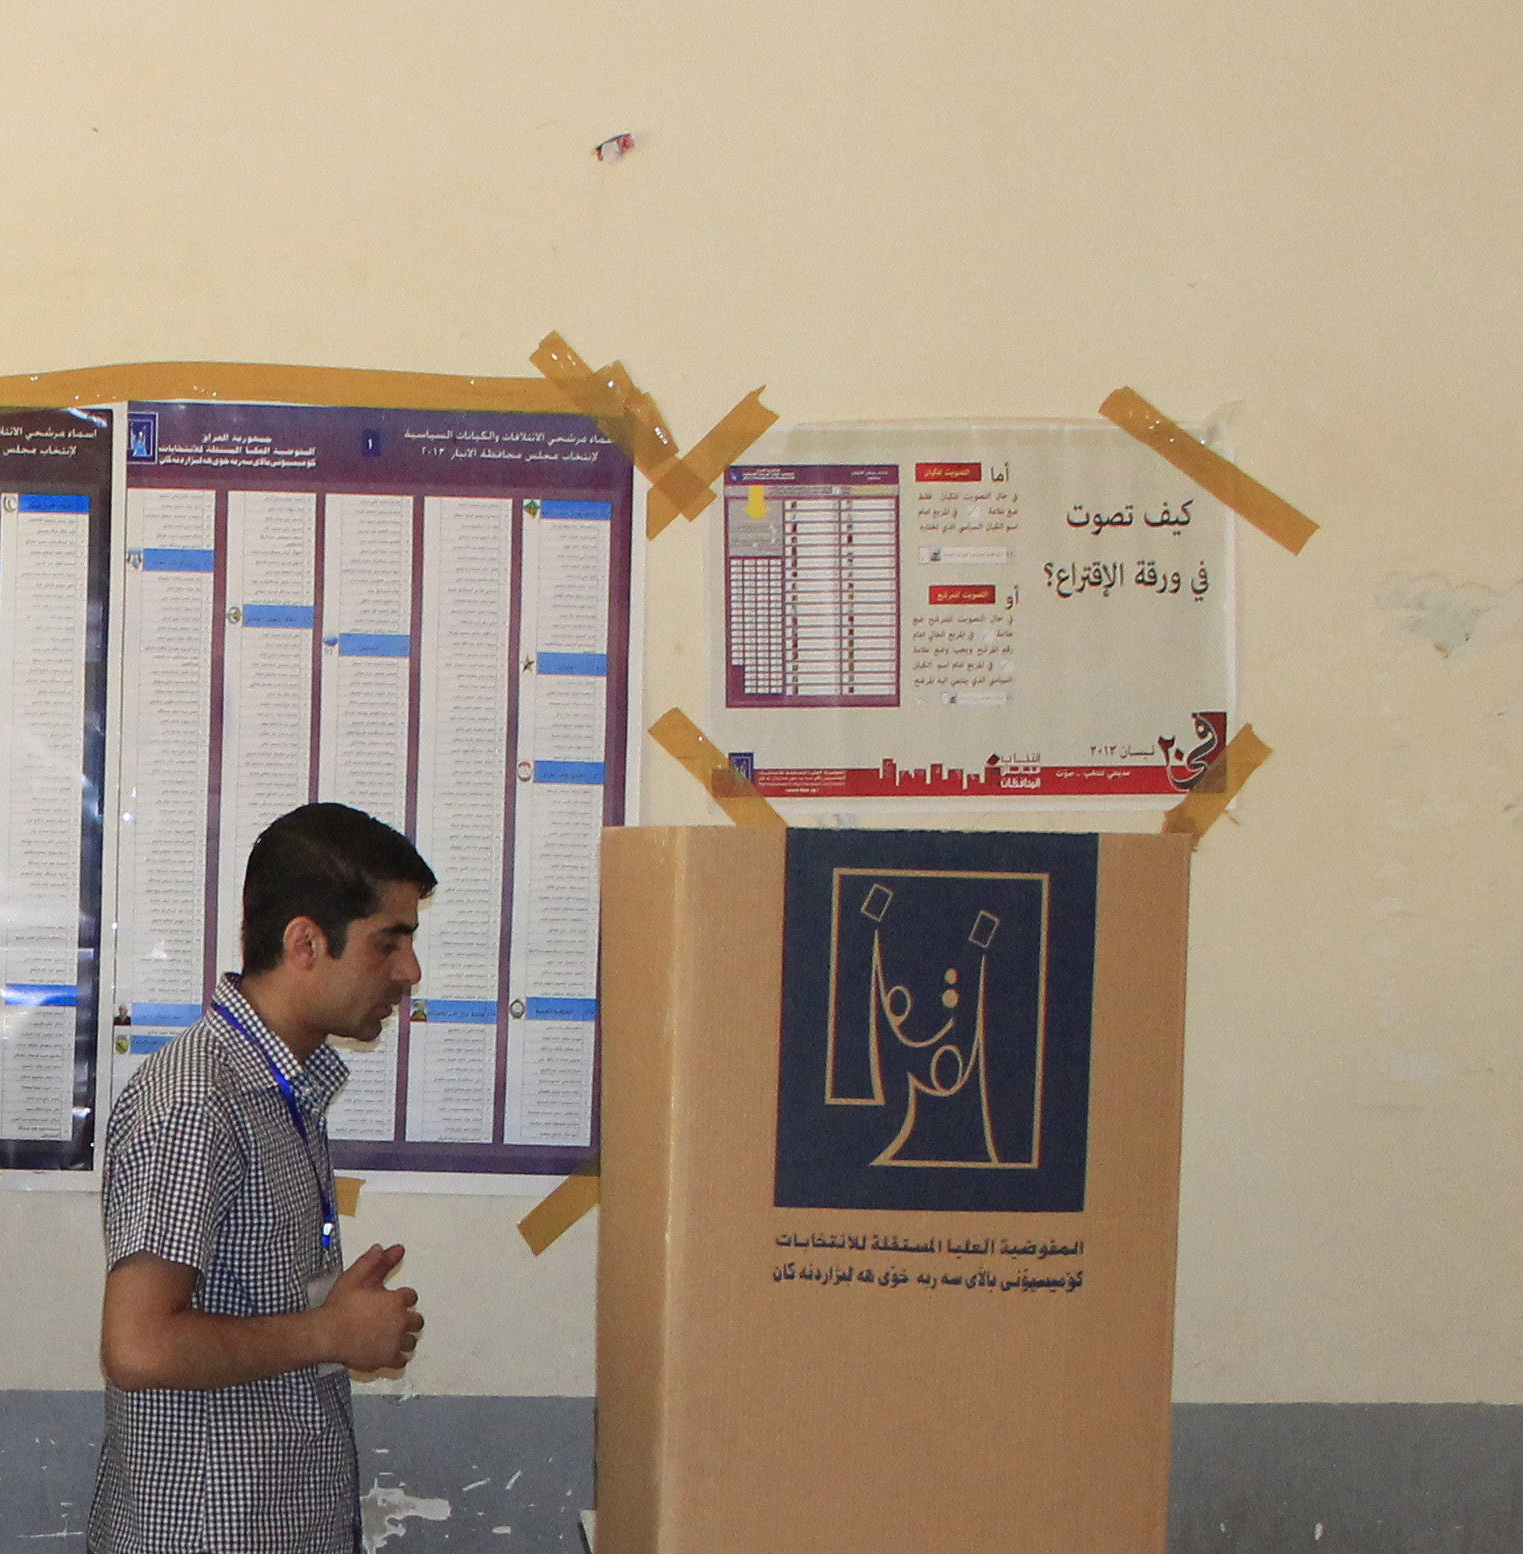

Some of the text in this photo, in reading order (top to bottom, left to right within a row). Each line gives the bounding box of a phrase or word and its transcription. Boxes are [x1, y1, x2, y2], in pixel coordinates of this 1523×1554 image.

[991, 461, 1009, 482] أما
[1066, 499, 1194, 536] كيف تصوت
[1044, 560, 1209, 603] في ورقة الإقتراع؟
[1004, 584, 1019, 610] أو
[1090, 745, 1117, 756] ٢٠١٣
[1120, 744, 1155, 759] نيسان
[775, 1233, 1084, 1260] المفوضية العليا المستقلة للانتخابات
